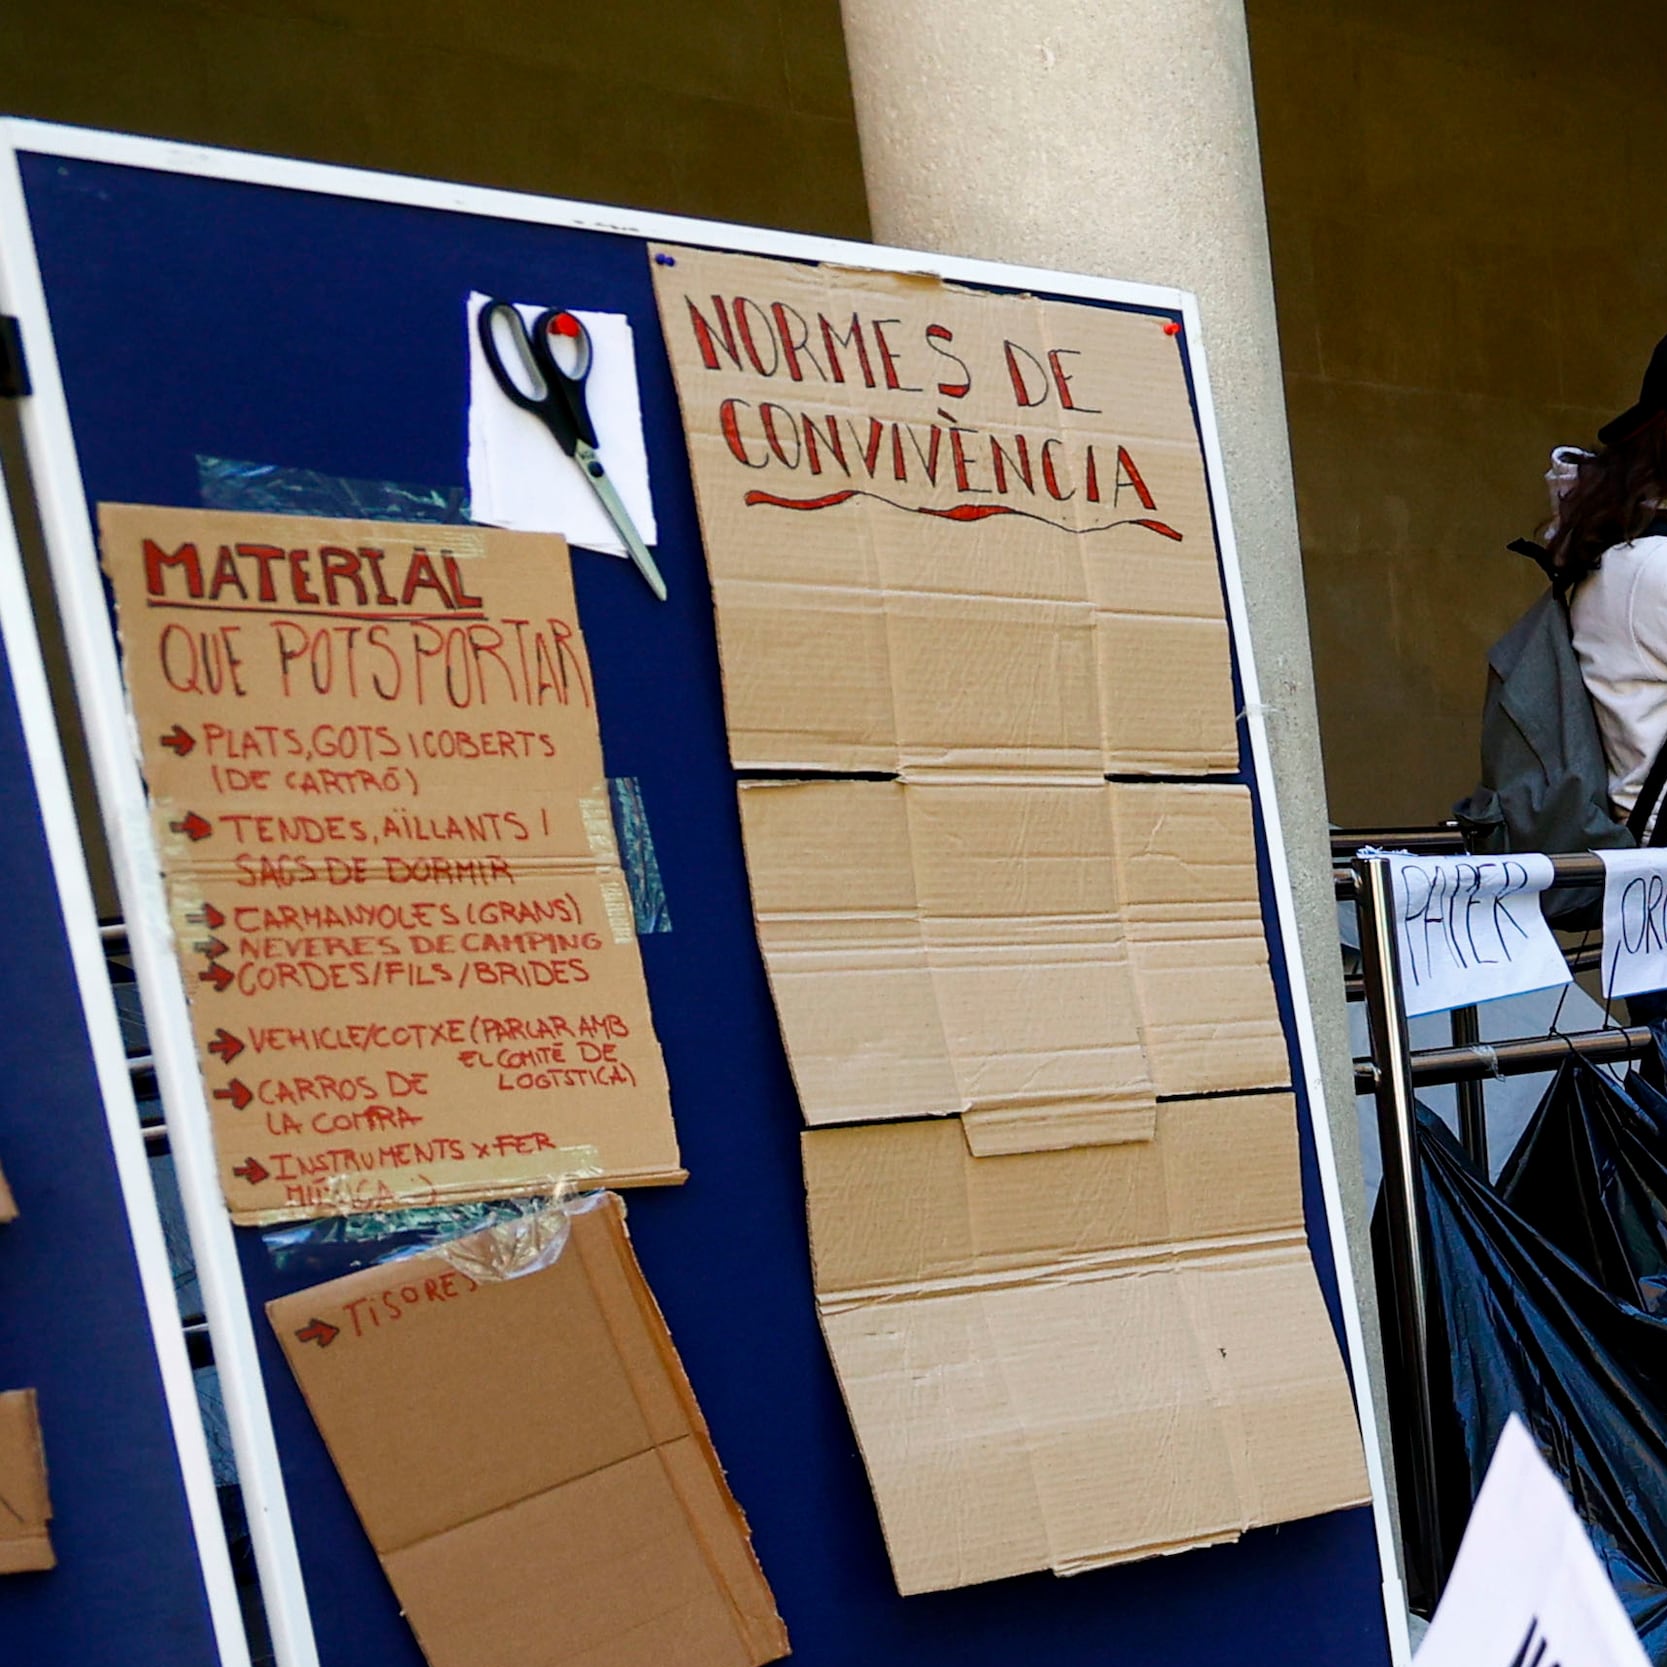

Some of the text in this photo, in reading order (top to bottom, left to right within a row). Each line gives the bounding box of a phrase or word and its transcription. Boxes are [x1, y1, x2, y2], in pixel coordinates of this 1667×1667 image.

[683, 292, 1103, 414] NORMES DE
[719, 396, 1158, 512] CONVIVÈNCIA
[142, 538, 485, 609] MATERIAL
[160, 617, 591, 708] QUE POTS PORTAR
[324, 855, 368, 886] DE
[382, 854, 516, 887] DORMIR
[233, 902, 461, 934] CARMANYOLES
[1401, 860, 1529, 987] PAPER
[239, 930, 604, 960] NEVERES DE CAMPING
[577, 1013, 631, 1041] AMB
[575, 1040, 619, 1064] DE
[257, 1070, 430, 1107] CARROS DE
[265, 1110, 304, 1136] LA
[268, 1137, 466, 1182] INSTRUMENTS
[491, 1131, 558, 1158] FER
